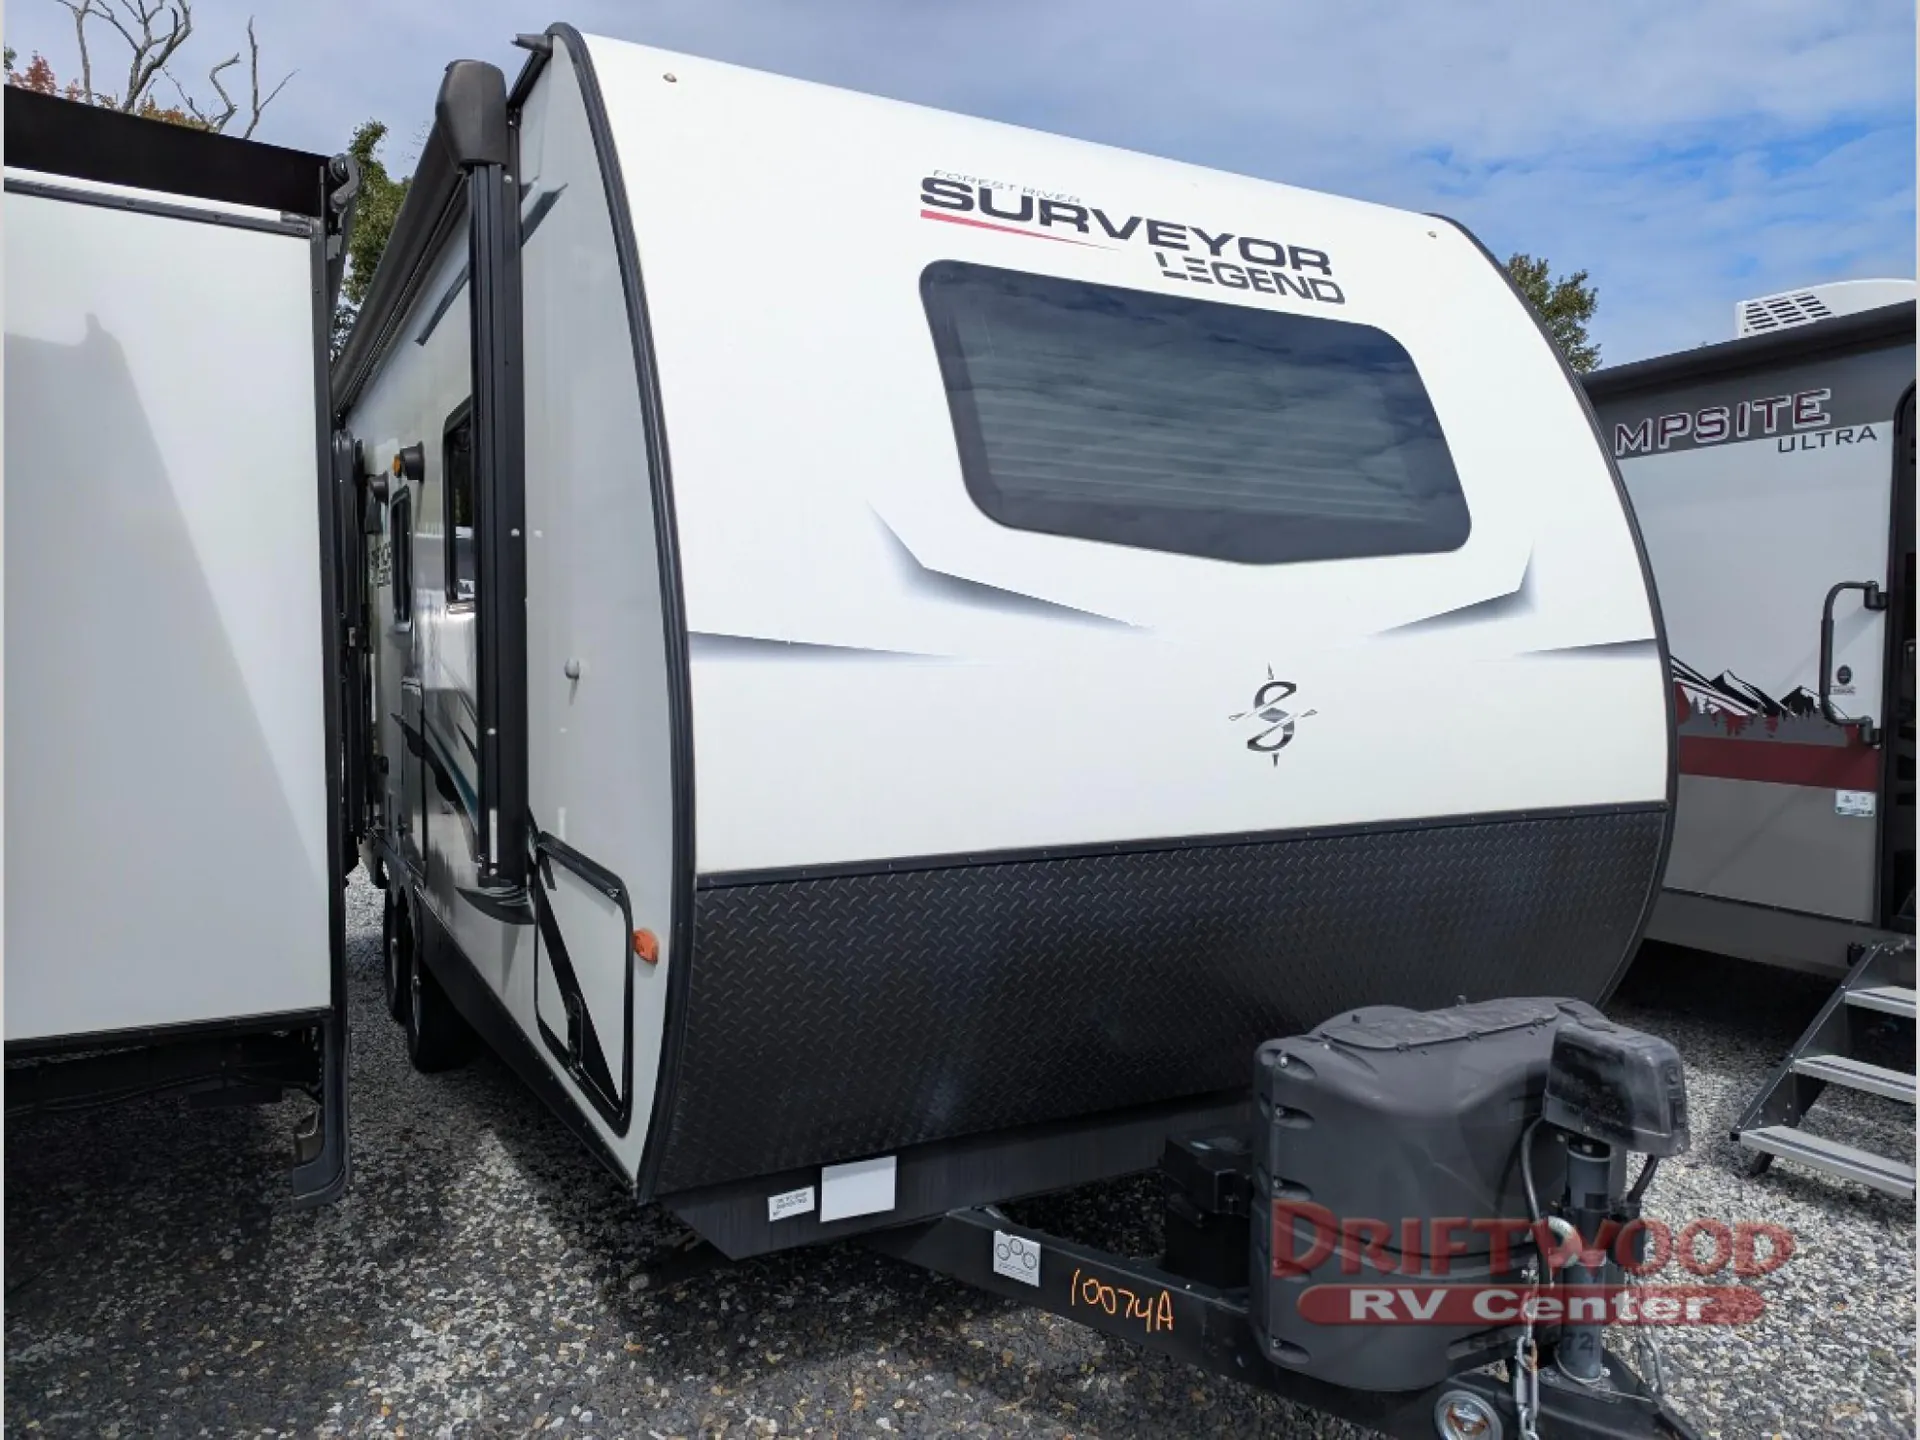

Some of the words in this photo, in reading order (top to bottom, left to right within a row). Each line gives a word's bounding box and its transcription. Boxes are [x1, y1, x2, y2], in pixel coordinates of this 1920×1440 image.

[933, 169, 1017, 191] FOREST
[920, 176, 1332, 276] SURVEYOR
[1154, 251, 1346, 304] LEGEND
[1777, 425, 1878, 453] ULTRA
[1071, 1267, 1174, 1334] 10074A
